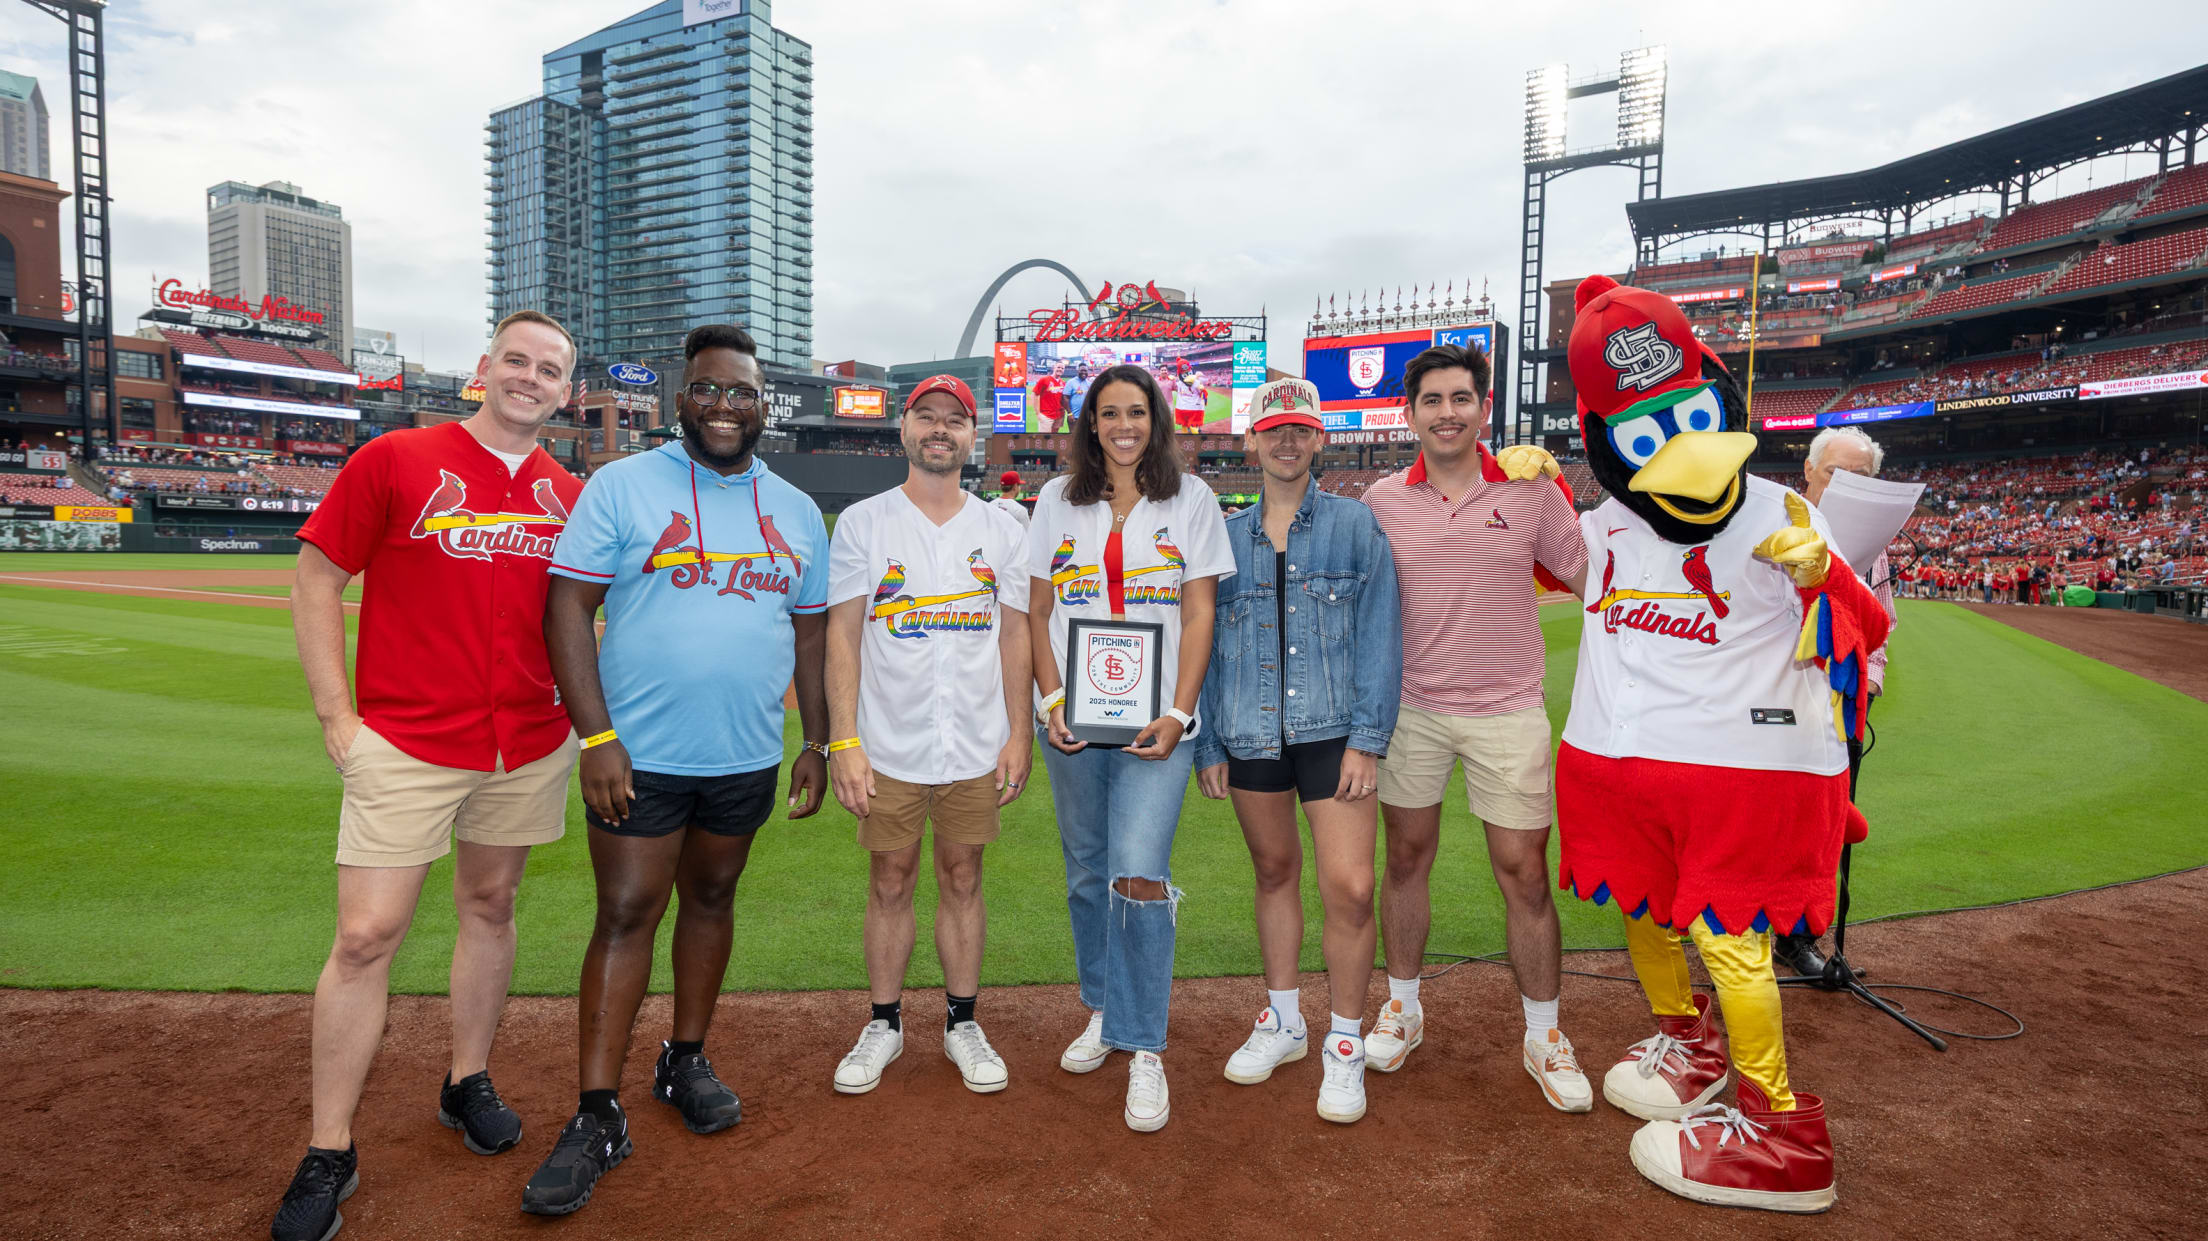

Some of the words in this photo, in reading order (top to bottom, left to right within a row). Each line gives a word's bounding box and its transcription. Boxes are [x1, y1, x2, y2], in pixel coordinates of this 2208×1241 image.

[1810, 221, 1863, 233] BUDWEISER
[1815, 243, 1869, 256] BUDWEISER
[159, 278, 251, 314] Cardinals
[250, 294, 325, 326] Nation
[1028, 308, 1233, 344] Budweiser
[1324, 318, 1381, 331] WORLD
[1383, 309, 1477, 325] CHAMPIONS
[259, 323, 311, 338] ROOFTOP
[356, 355, 403, 369] FANDUEL
[619, 365, 649, 382] Ford
[2104, 381, 2151, 391] DIERBERGS
[2153, 373, 2197, 385] DELIVERS
[777, 393, 802, 407] THE
[1262, 384, 1314, 413] CARDINALS
[1937, 395, 2011, 412] LINDENWOOD
[2012, 387, 2077, 405] UNIVERSITY
[1322, 415, 1349, 425] TIFEL
[1365, 413, 1396, 426] PROUD
[1543, 414, 1580, 430] bet
[1330, 432, 1375, 444] BROWN
[1377, 434, 1385, 442] &
[71, 508, 118, 517] DOBBS
[261, 500, 284, 510] 6:19
[201, 539, 259, 551] Spectrum
[439, 524, 561, 562] Cardina
[671, 559, 718, 590] St.
[717, 557, 791, 603] Louis
[886, 603, 993, 639] Cardinals
[1604, 601, 1721, 646] Crdinals
[1092, 637, 1132, 648] PITCHING
[1089, 697, 1107, 705] 2025
[1108, 698, 1138, 707] HONOREE
